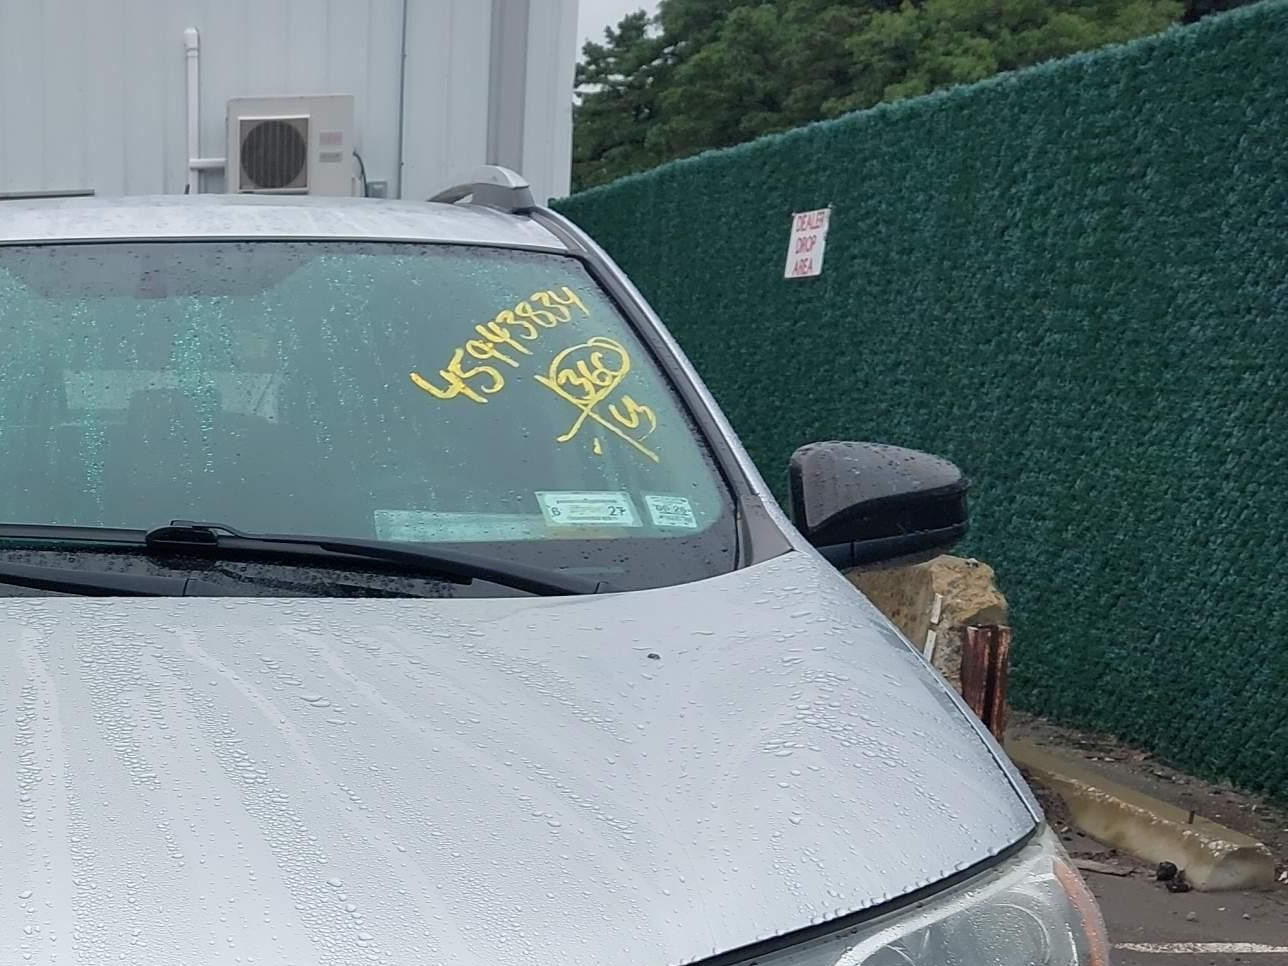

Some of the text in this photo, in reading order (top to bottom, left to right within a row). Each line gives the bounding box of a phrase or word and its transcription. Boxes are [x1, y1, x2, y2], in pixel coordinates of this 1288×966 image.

[796, 211, 825, 232] DEALER
[795, 235, 817, 254] DROP
[792, 258, 813, 275] AREA
[410, 286, 591, 404] 45943834
